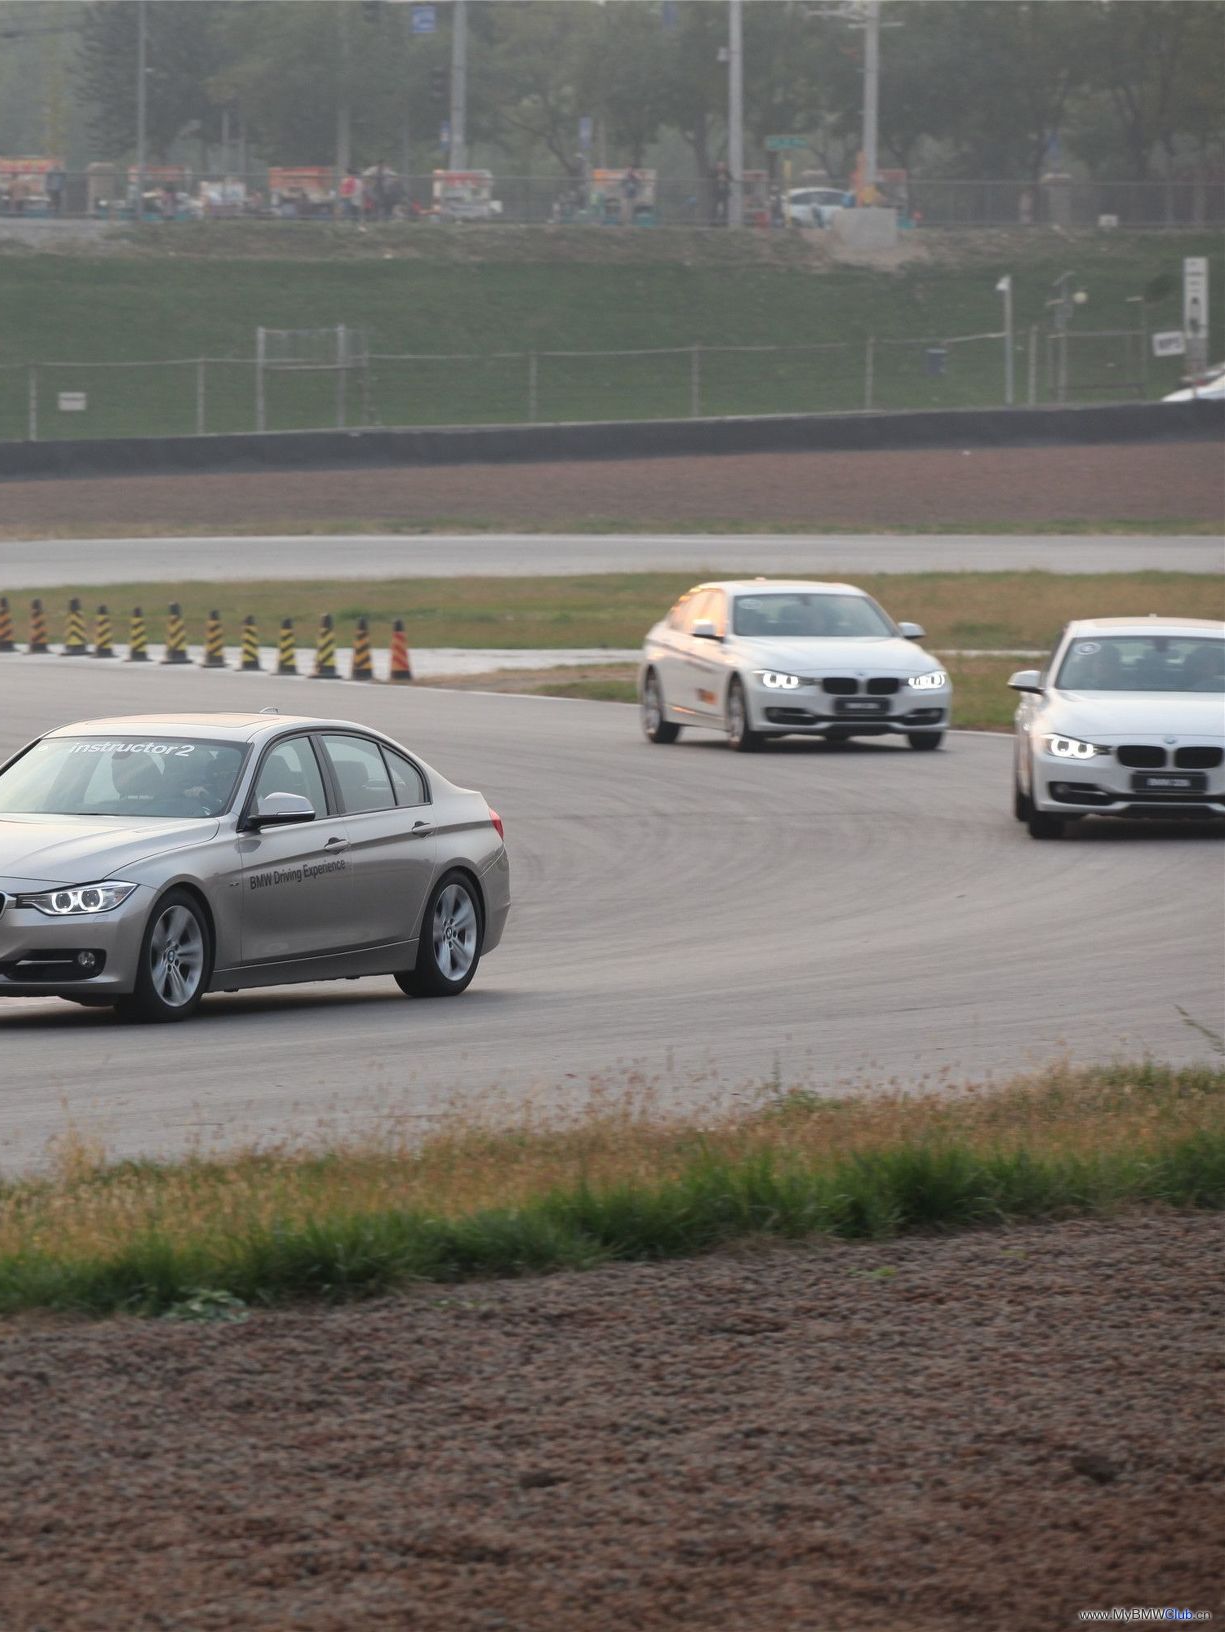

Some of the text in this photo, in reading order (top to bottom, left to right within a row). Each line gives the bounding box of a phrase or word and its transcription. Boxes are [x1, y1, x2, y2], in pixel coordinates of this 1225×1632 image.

[249, 859, 346, 890] BMW Driving Experience
